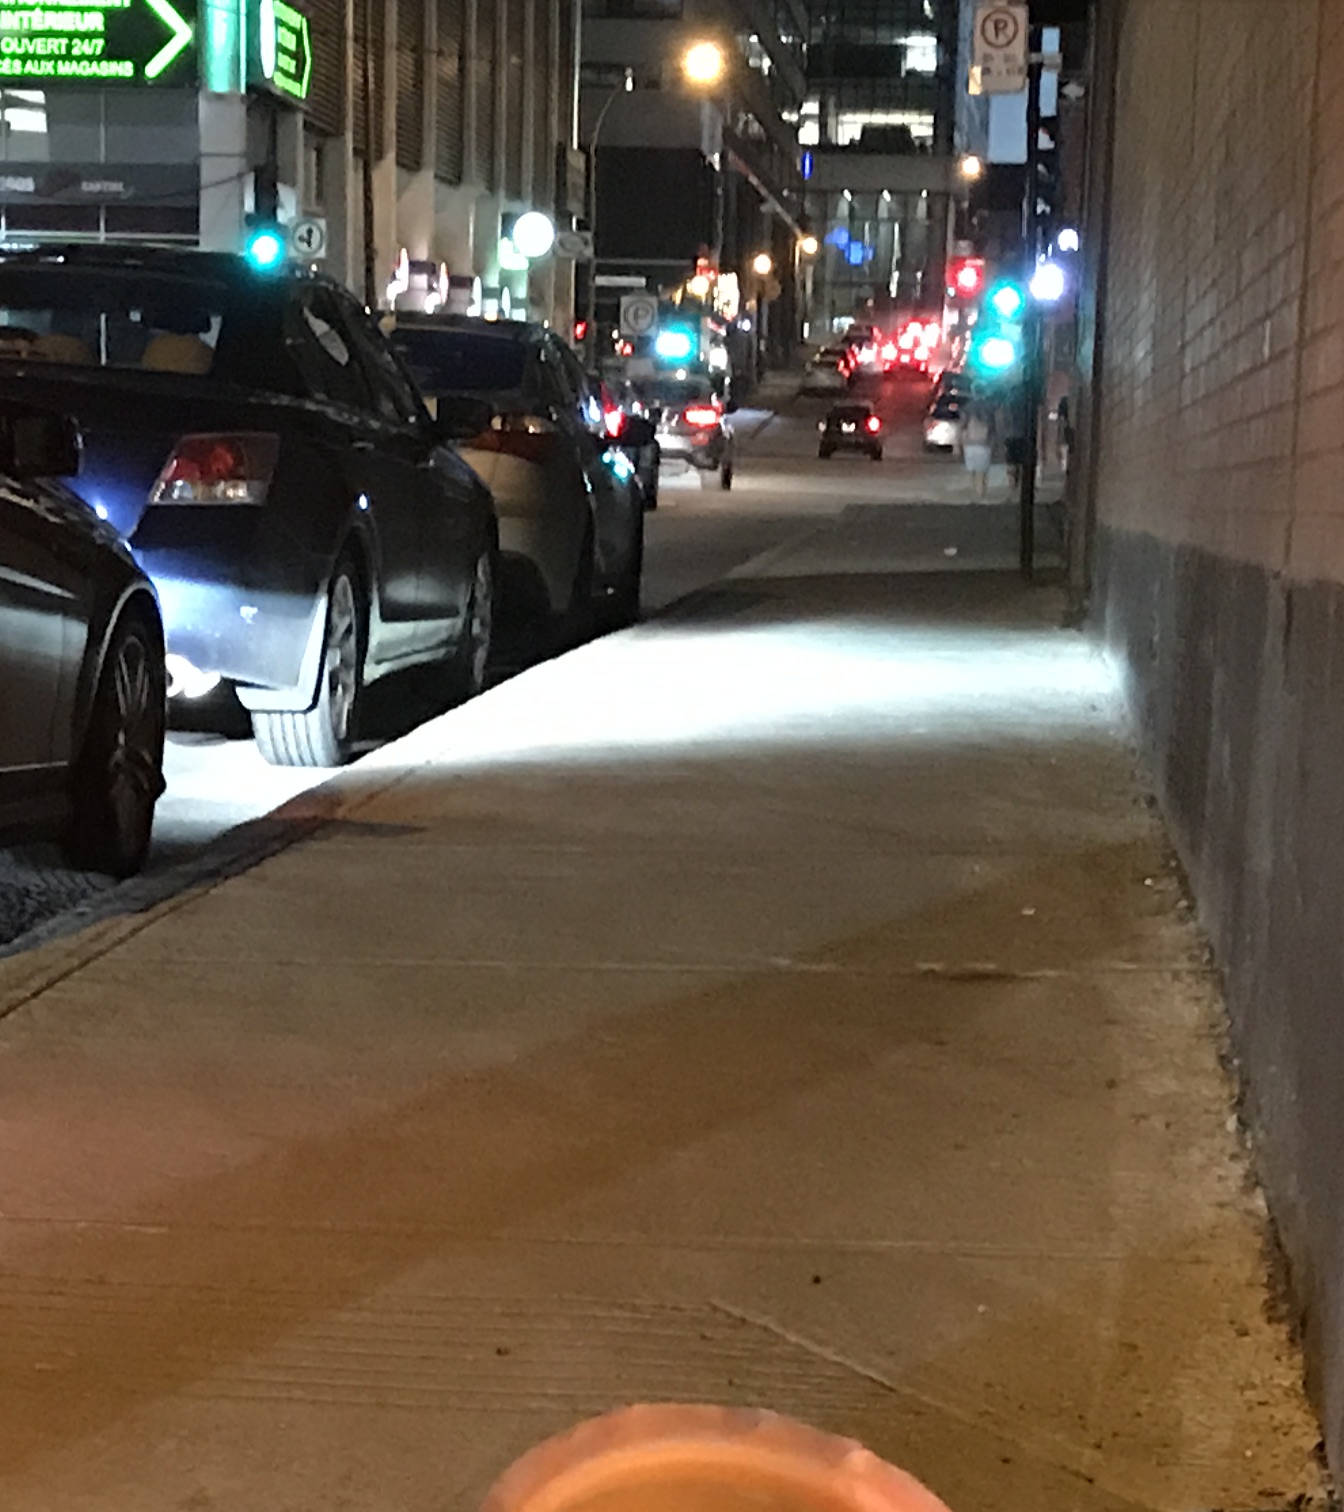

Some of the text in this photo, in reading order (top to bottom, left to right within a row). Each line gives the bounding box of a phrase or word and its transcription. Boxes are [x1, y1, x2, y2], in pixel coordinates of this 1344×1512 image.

[0, 7, 105, 31] INTÉRIEUR
[0, 37, 105, 56] OUVERT 24/7
[23, 60, 55, 75] AUX
[56, 60, 134, 77] MAGASINS
